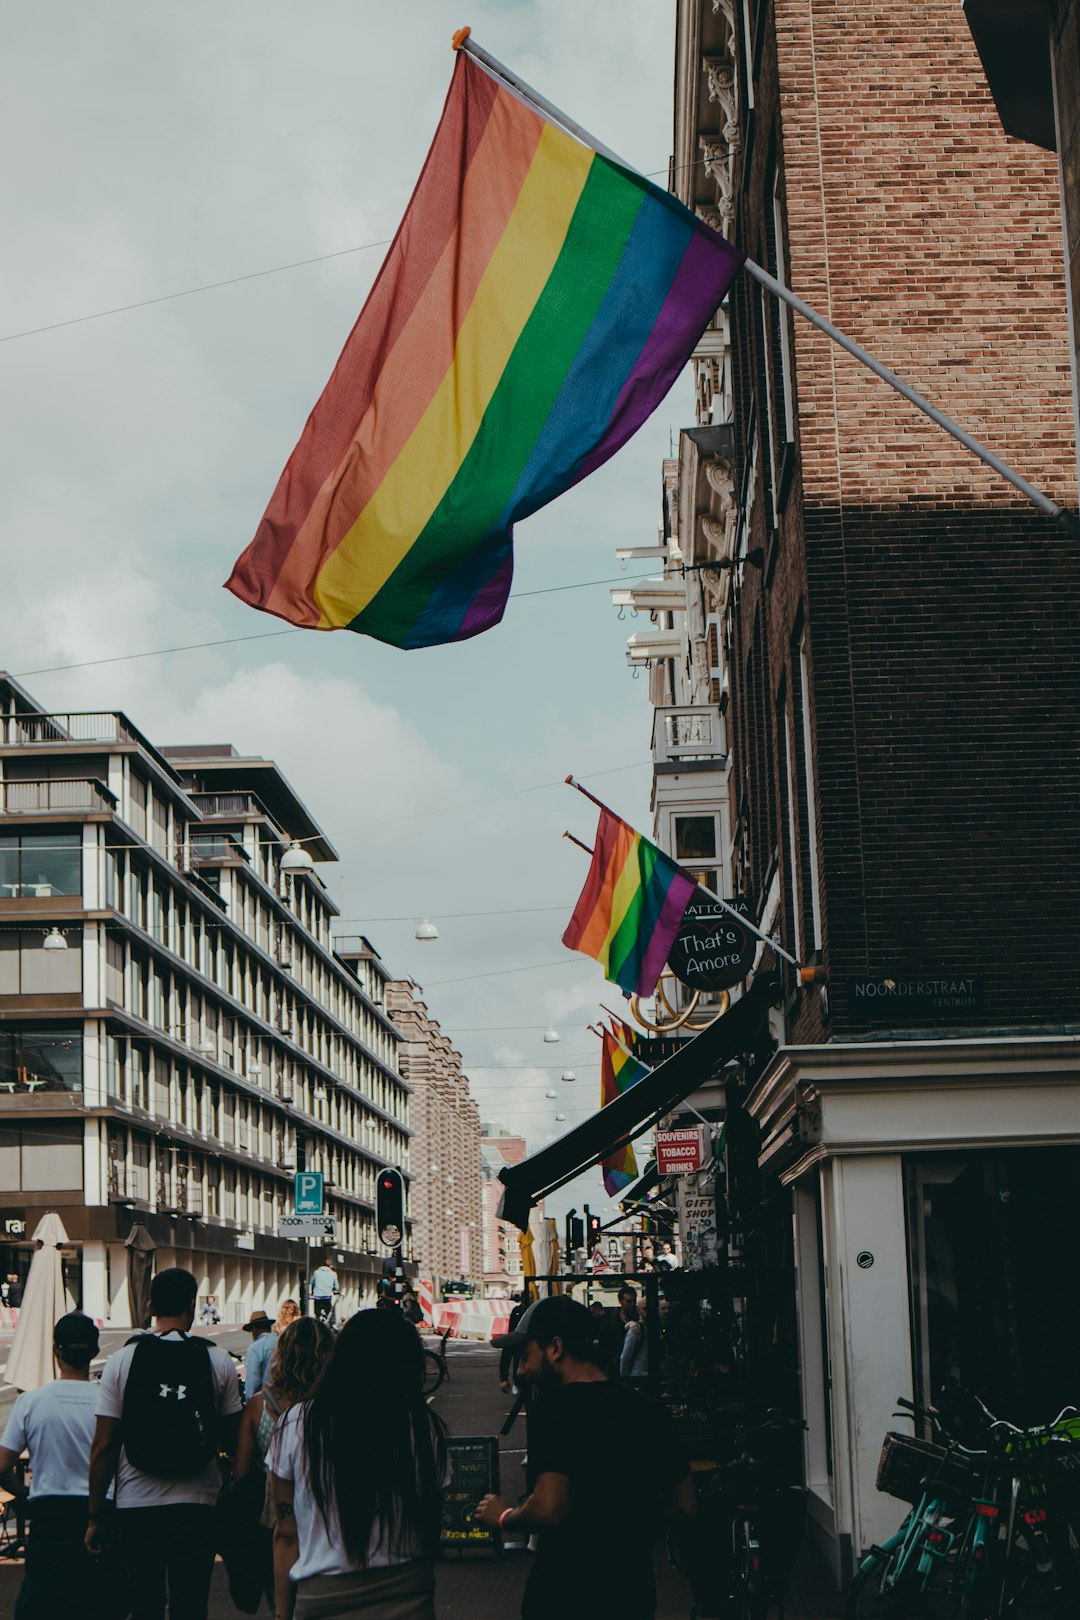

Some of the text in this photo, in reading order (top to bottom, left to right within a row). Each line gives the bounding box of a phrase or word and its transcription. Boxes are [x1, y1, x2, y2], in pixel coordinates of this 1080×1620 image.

[685, 902, 748, 915] ATTOIA
[679, 928, 737, 954] That's
[686, 953, 741, 976] Amore
[855, 979, 975, 997] NOORDERSTRAAT
[933, 997, 976, 1007] CENTRUM
[657, 1131, 698, 1142] SOUVENIRS
[661, 1147, 696, 1157] TOBACCO
[666, 1162, 693, 1172] DRINKS
[301, 1176, 316, 1197] P
[685, 1199, 712, 1208] GIFT
[685, 1210, 714, 1218] SHOP
